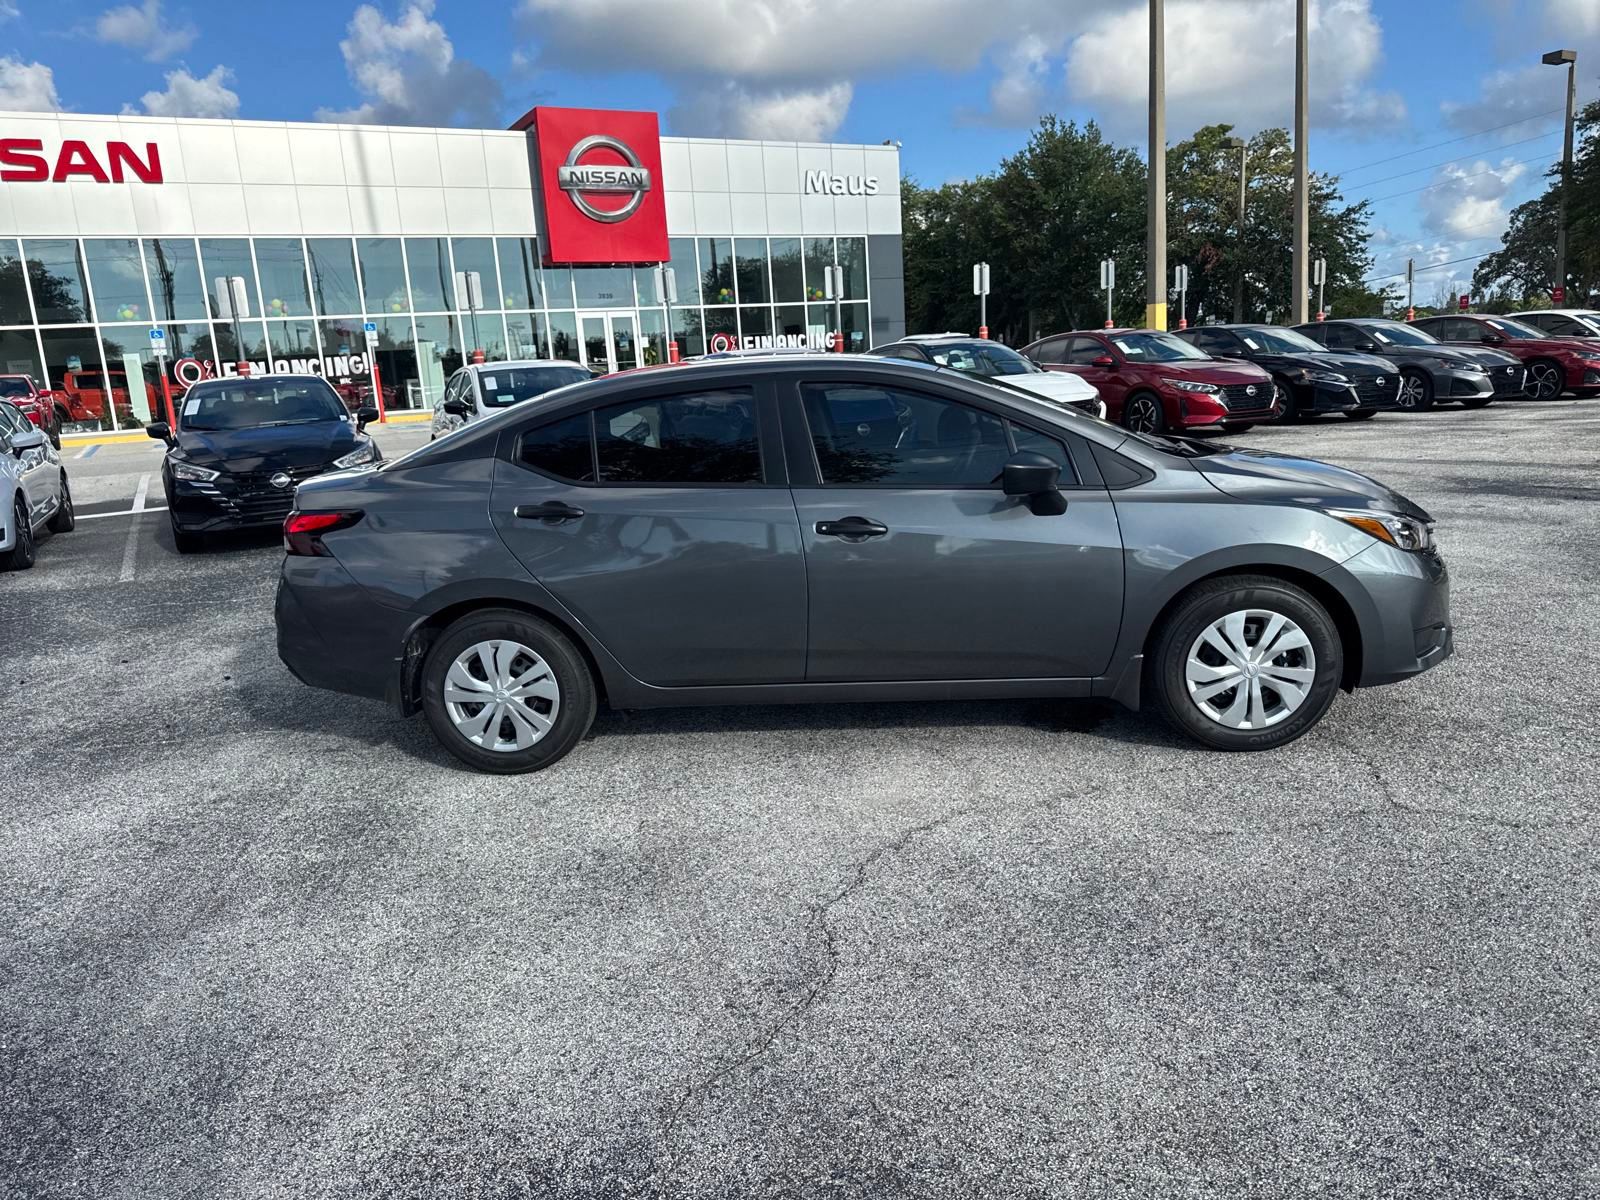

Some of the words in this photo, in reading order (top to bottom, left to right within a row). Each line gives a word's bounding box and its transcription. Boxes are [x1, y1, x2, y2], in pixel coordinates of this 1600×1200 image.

[569, 171, 644, 185] NISSAN
[804, 169, 879, 196] Maus
[743, 329, 838, 350] FINANCING
[222, 352, 370, 377] FNANCING!
[1247, 716, 1306, 745] KUMHO
